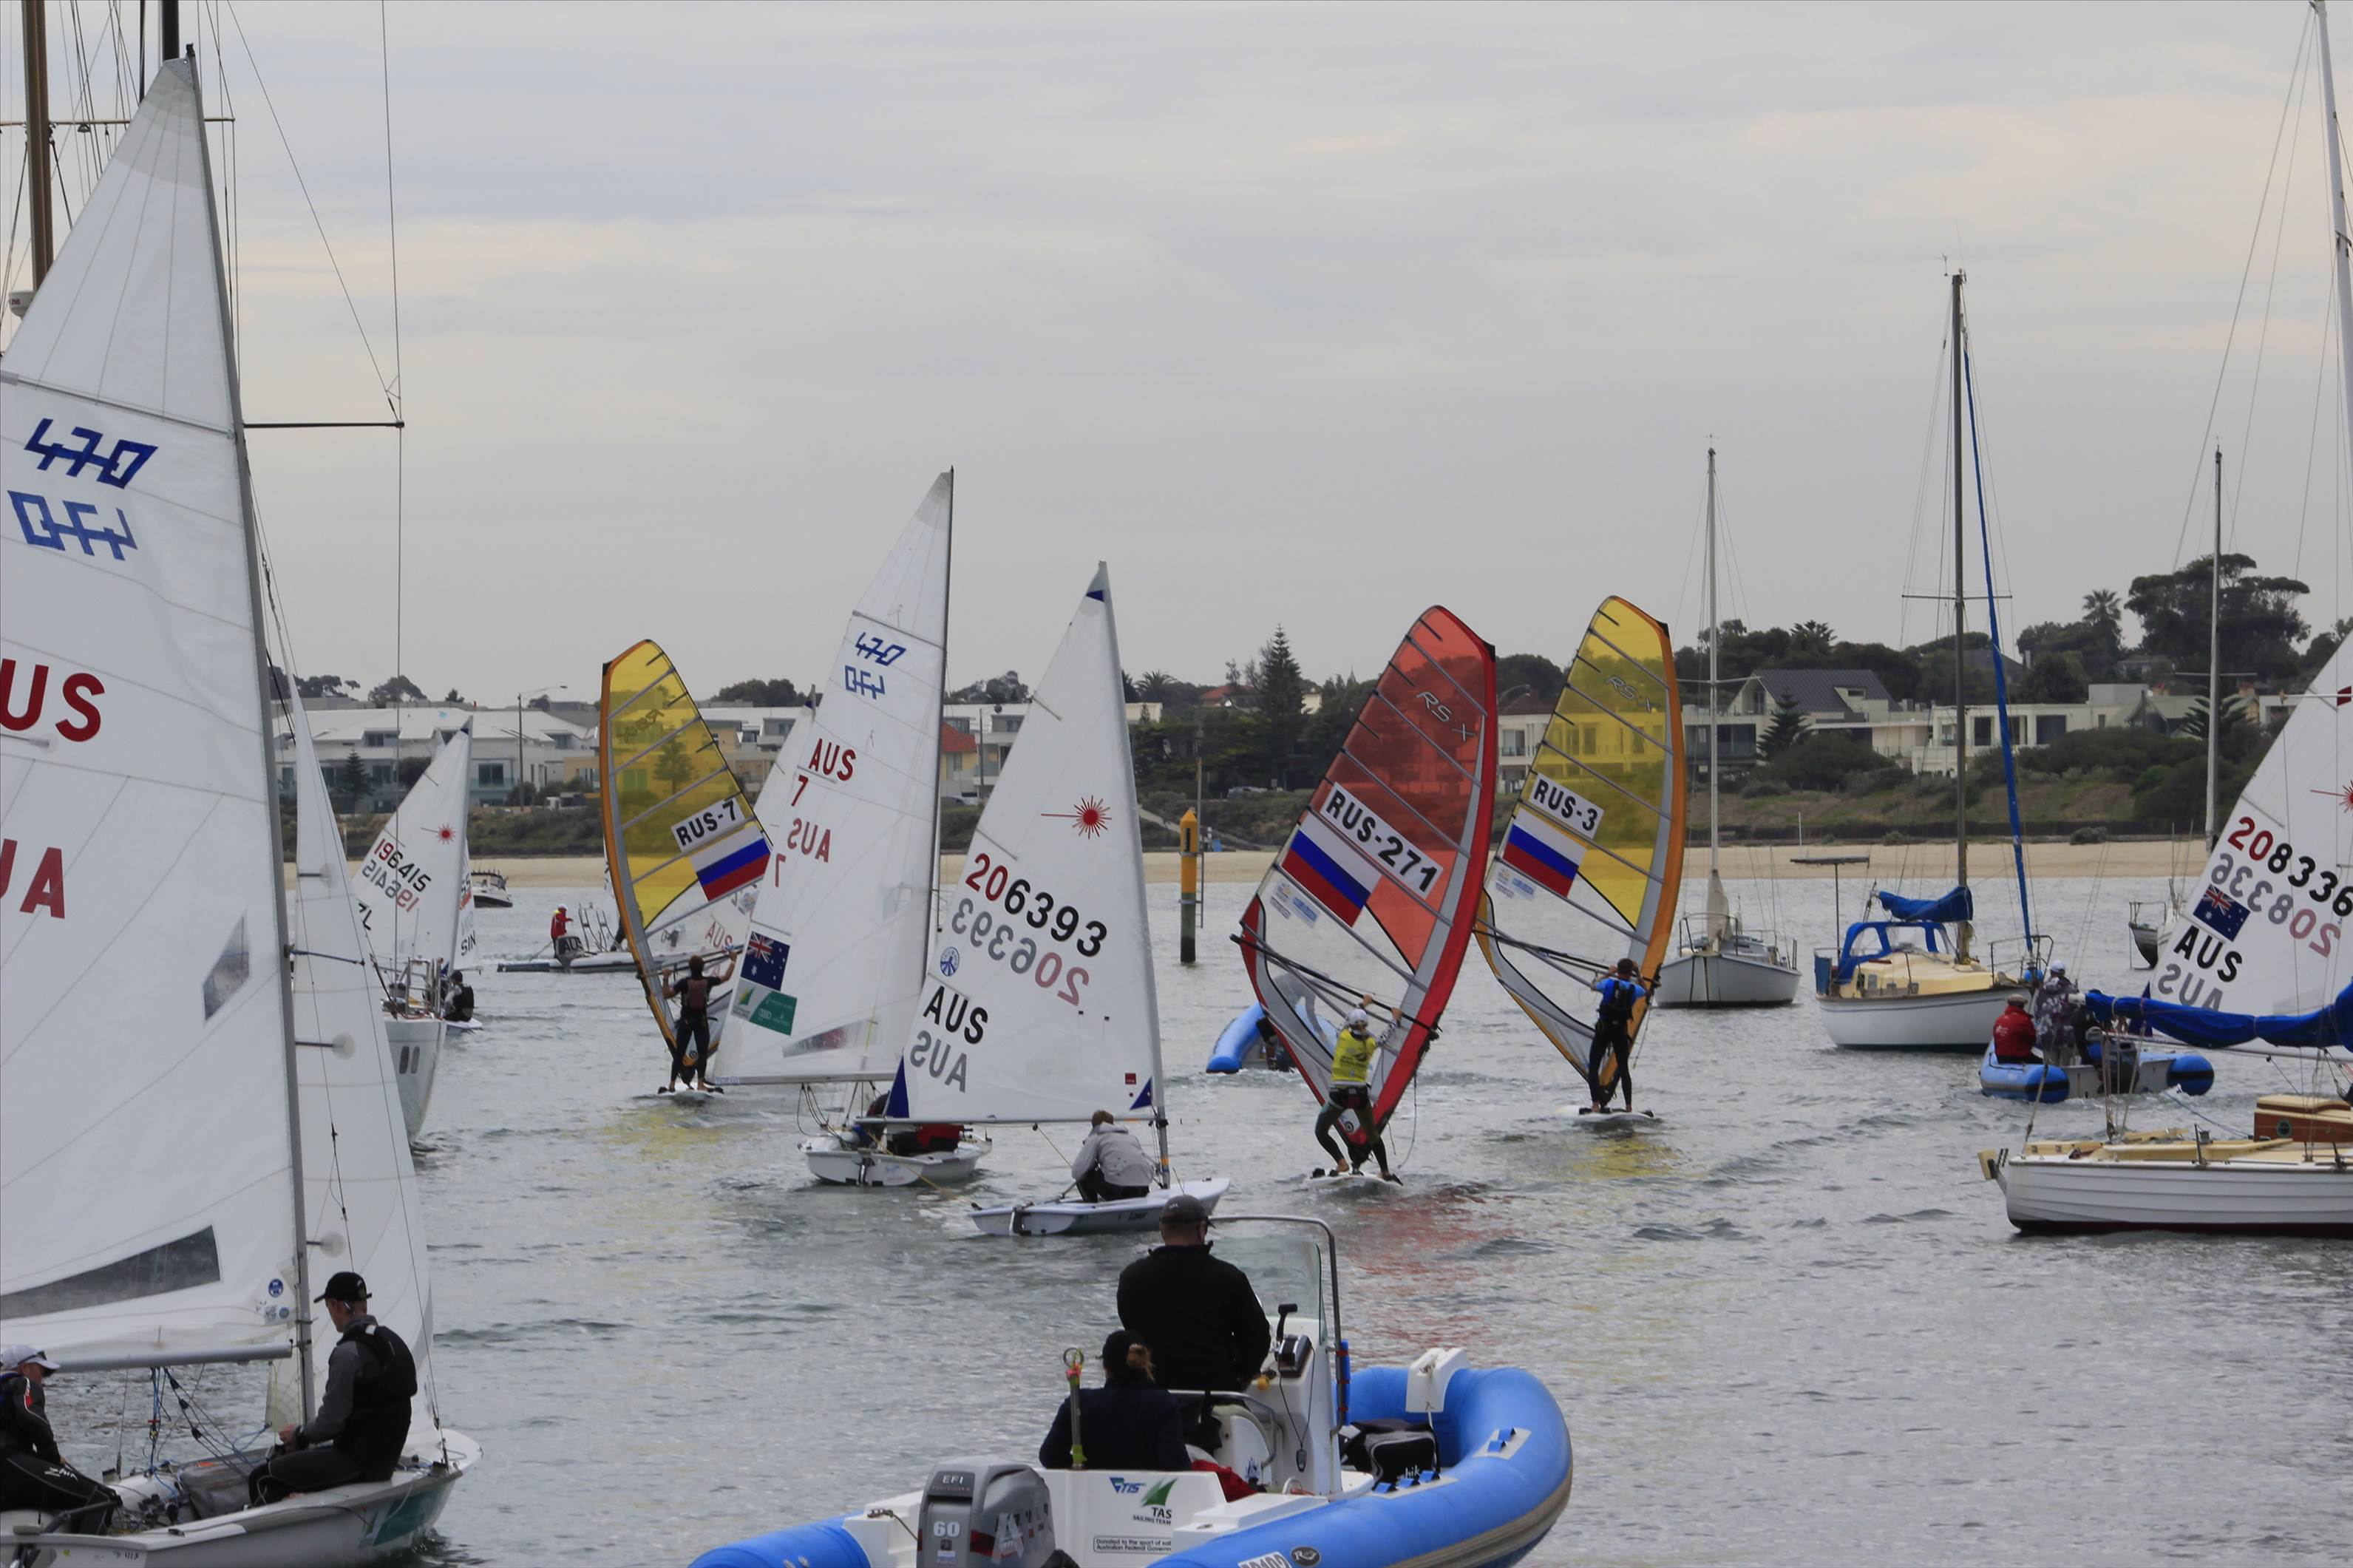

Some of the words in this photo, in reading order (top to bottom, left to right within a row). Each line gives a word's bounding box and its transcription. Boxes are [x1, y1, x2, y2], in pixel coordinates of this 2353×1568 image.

[24, 418, 158, 489] 470
[855, 631, 906, 666] 470
[808, 738, 856, 781] AUS
[791, 774, 809, 807] 7
[1533, 778, 1598, 831] RUS-3
[676, 800, 736, 846] RUS-7
[1326, 790, 1438, 892] RUS-271
[373, 838, 432, 892] 196415
[2227, 816, 2353, 917] 208336
[965, 852, 1107, 957] 206393
[2173, 924, 2243, 982] AUS
[923, 985, 988, 1045] AUS
[943, 1476, 963, 1484] EFI
[934, 1521, 960, 1537] 60
[1133, 1515, 1155, 1524] SAILING
[1152, 1507, 1172, 1518] TAS
